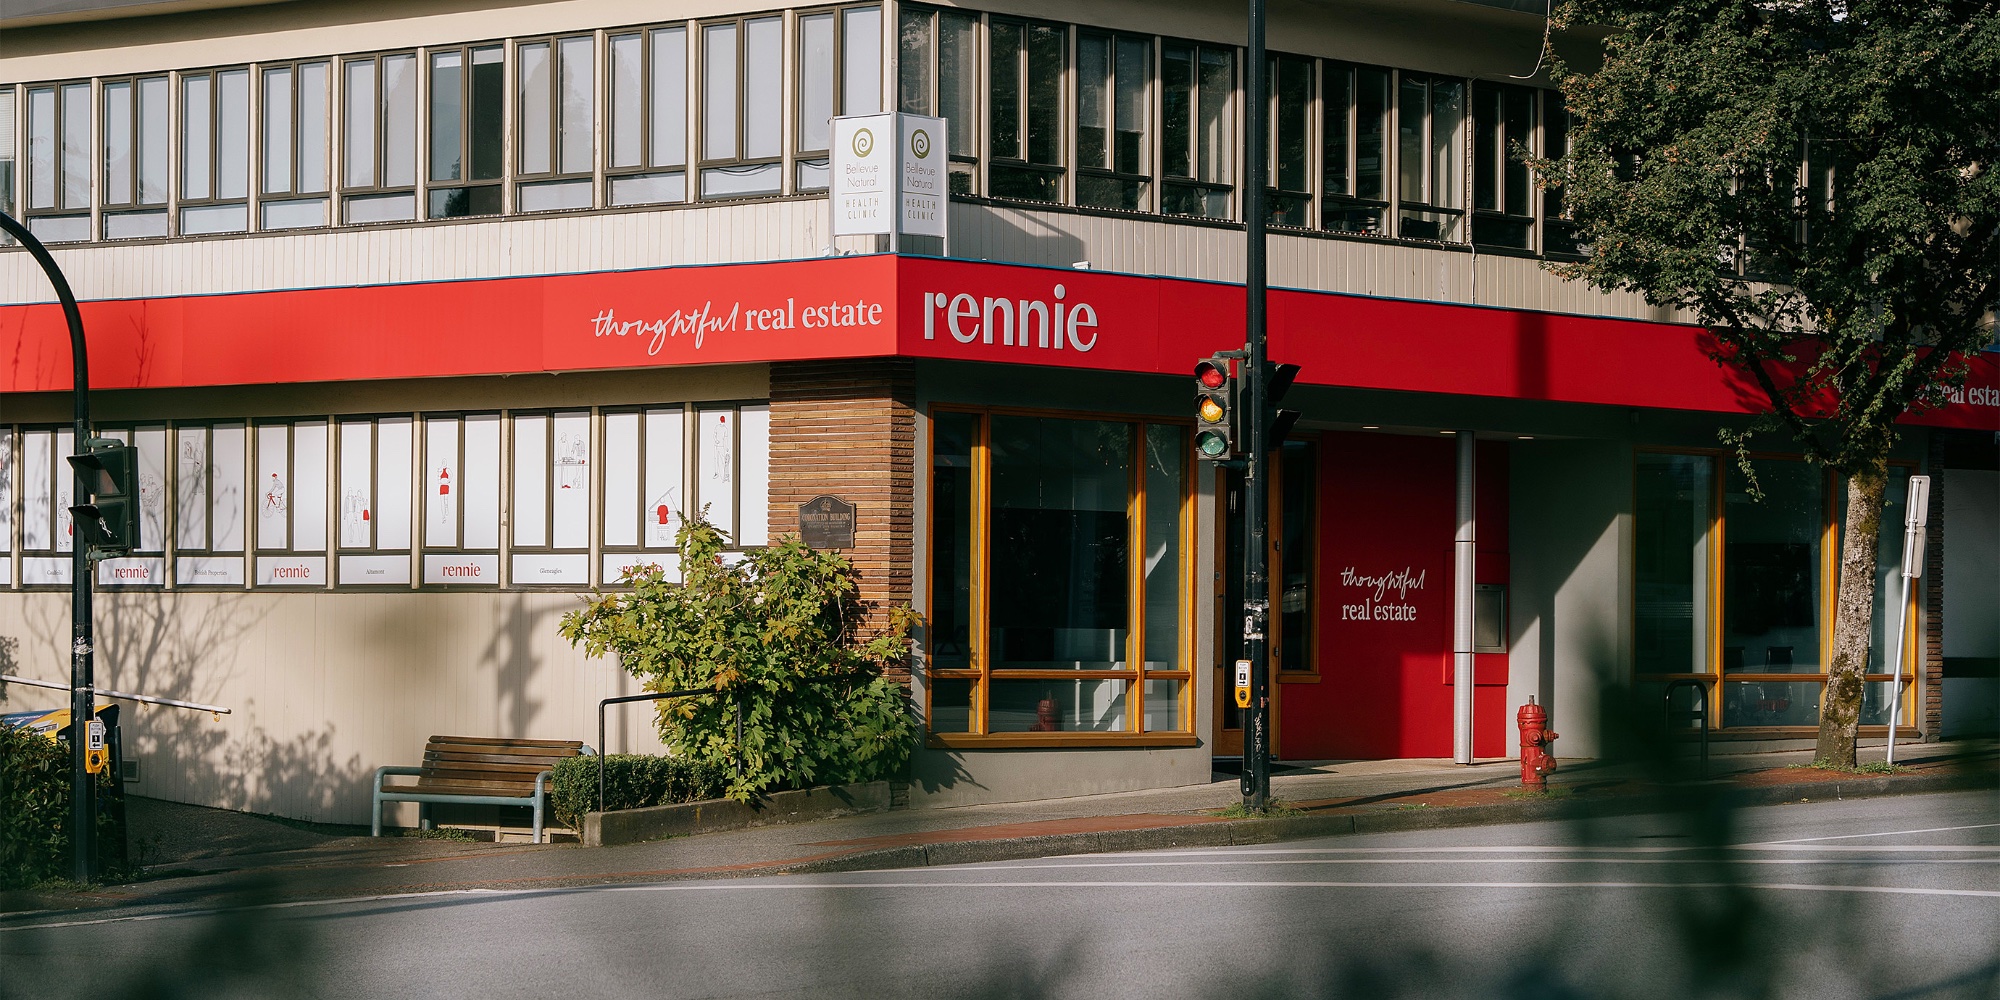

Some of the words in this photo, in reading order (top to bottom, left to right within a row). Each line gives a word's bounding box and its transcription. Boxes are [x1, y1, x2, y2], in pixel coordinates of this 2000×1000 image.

[846, 162, 879, 175] Bellevue
[905, 161, 936, 176] Bellevue
[847, 175, 877, 188] Natural
[906, 176, 935, 189] Natural
[845, 197, 879, 208] HEALTH
[905, 198, 936, 210] HEALTH
[847, 209, 877, 220] CLINIC
[907, 209, 935, 221] CLINIC
[923, 283, 1099, 352] rennie
[590, 301, 739, 355] thoughtful
[744, 297, 796, 331] real
[801, 299, 884, 329] estate
[115, 564, 149, 579] rennie
[274, 564, 310, 578] rennie
[442, 563, 482, 577] rennie
[1340, 566, 1426, 603] thoughtful
[1341, 598, 1371, 621] real
[1373, 602, 1417, 622] estate
